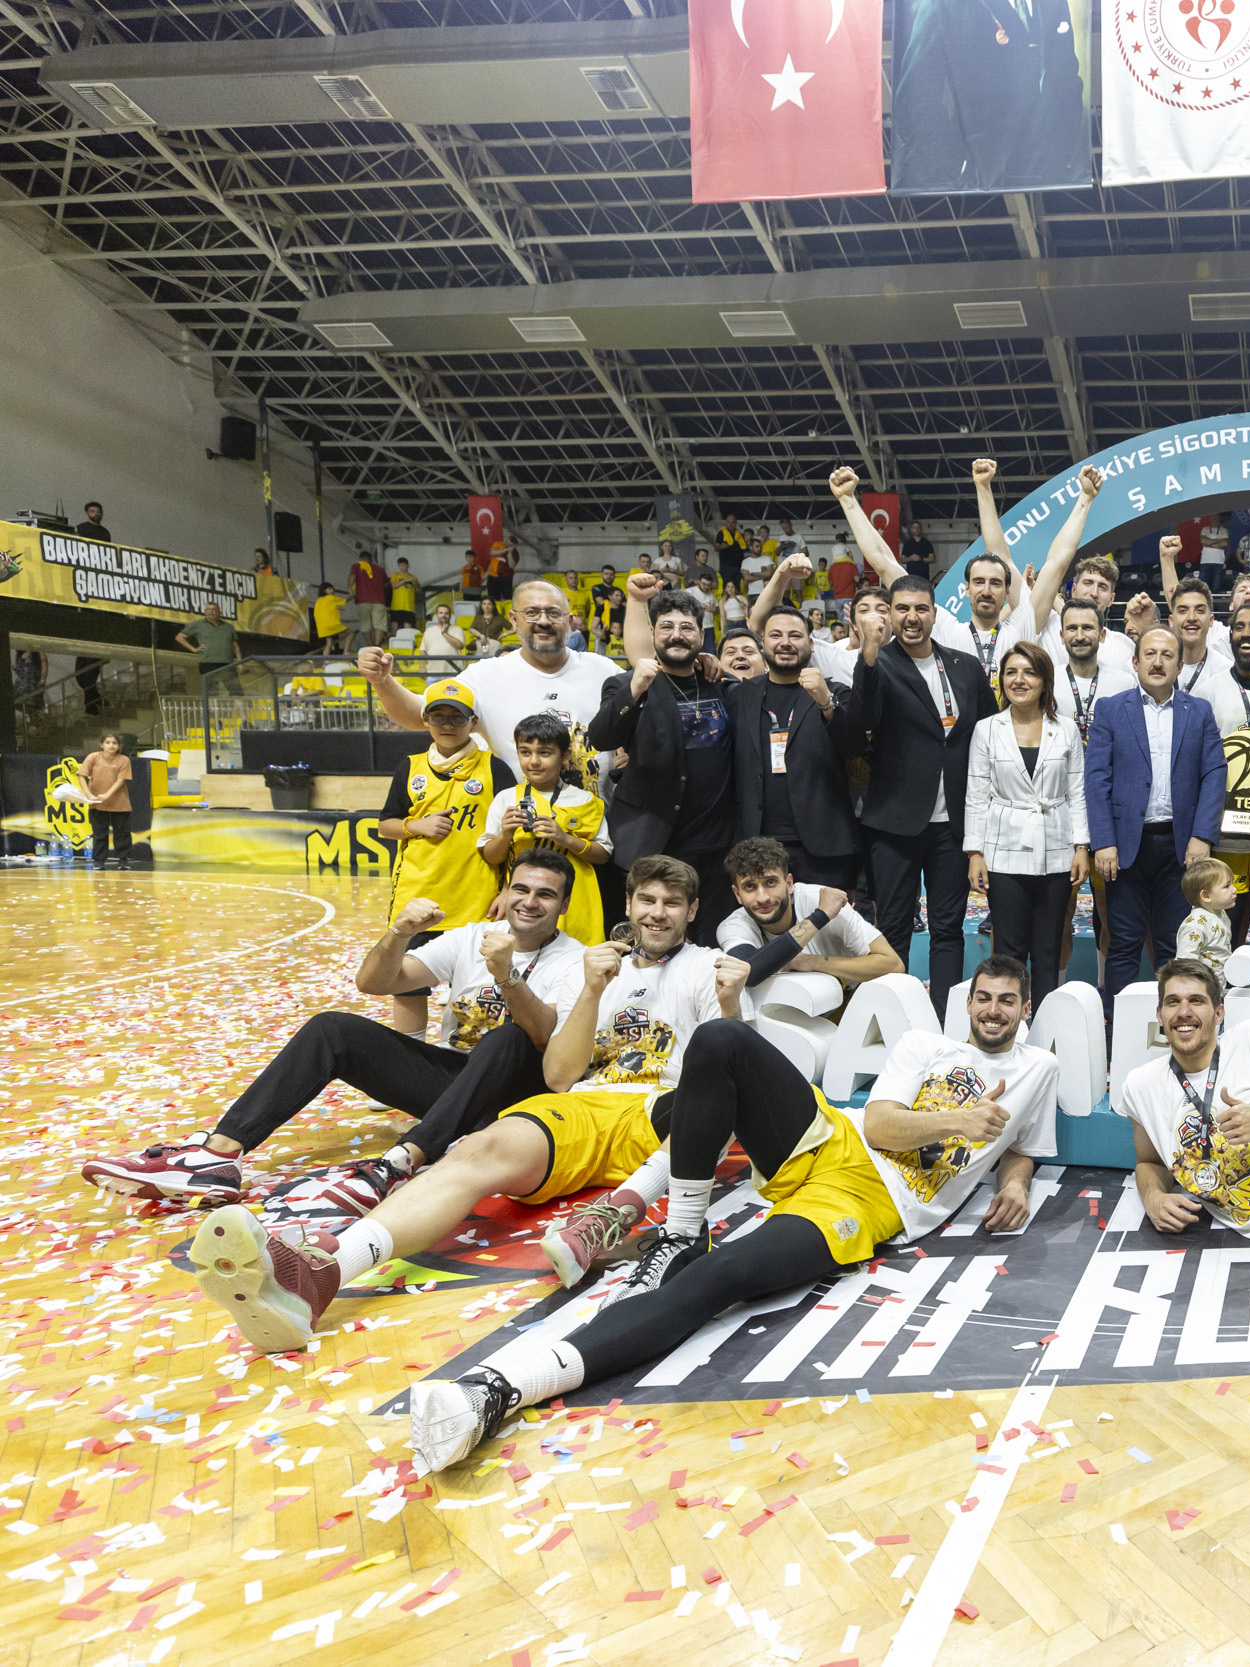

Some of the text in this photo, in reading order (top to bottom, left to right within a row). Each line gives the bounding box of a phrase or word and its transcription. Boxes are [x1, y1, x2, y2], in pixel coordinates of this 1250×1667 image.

[1050, 446, 1155, 505] TÜKİYE
[42, 534, 149, 578] BAYRAKLARI
[149, 555, 225, 592] AKDENİZ'E
[225, 571, 256, 600] AÇIN
[75, 569, 190, 611] ŞAMPİYONLUK
[48, 801, 86, 824] MS
